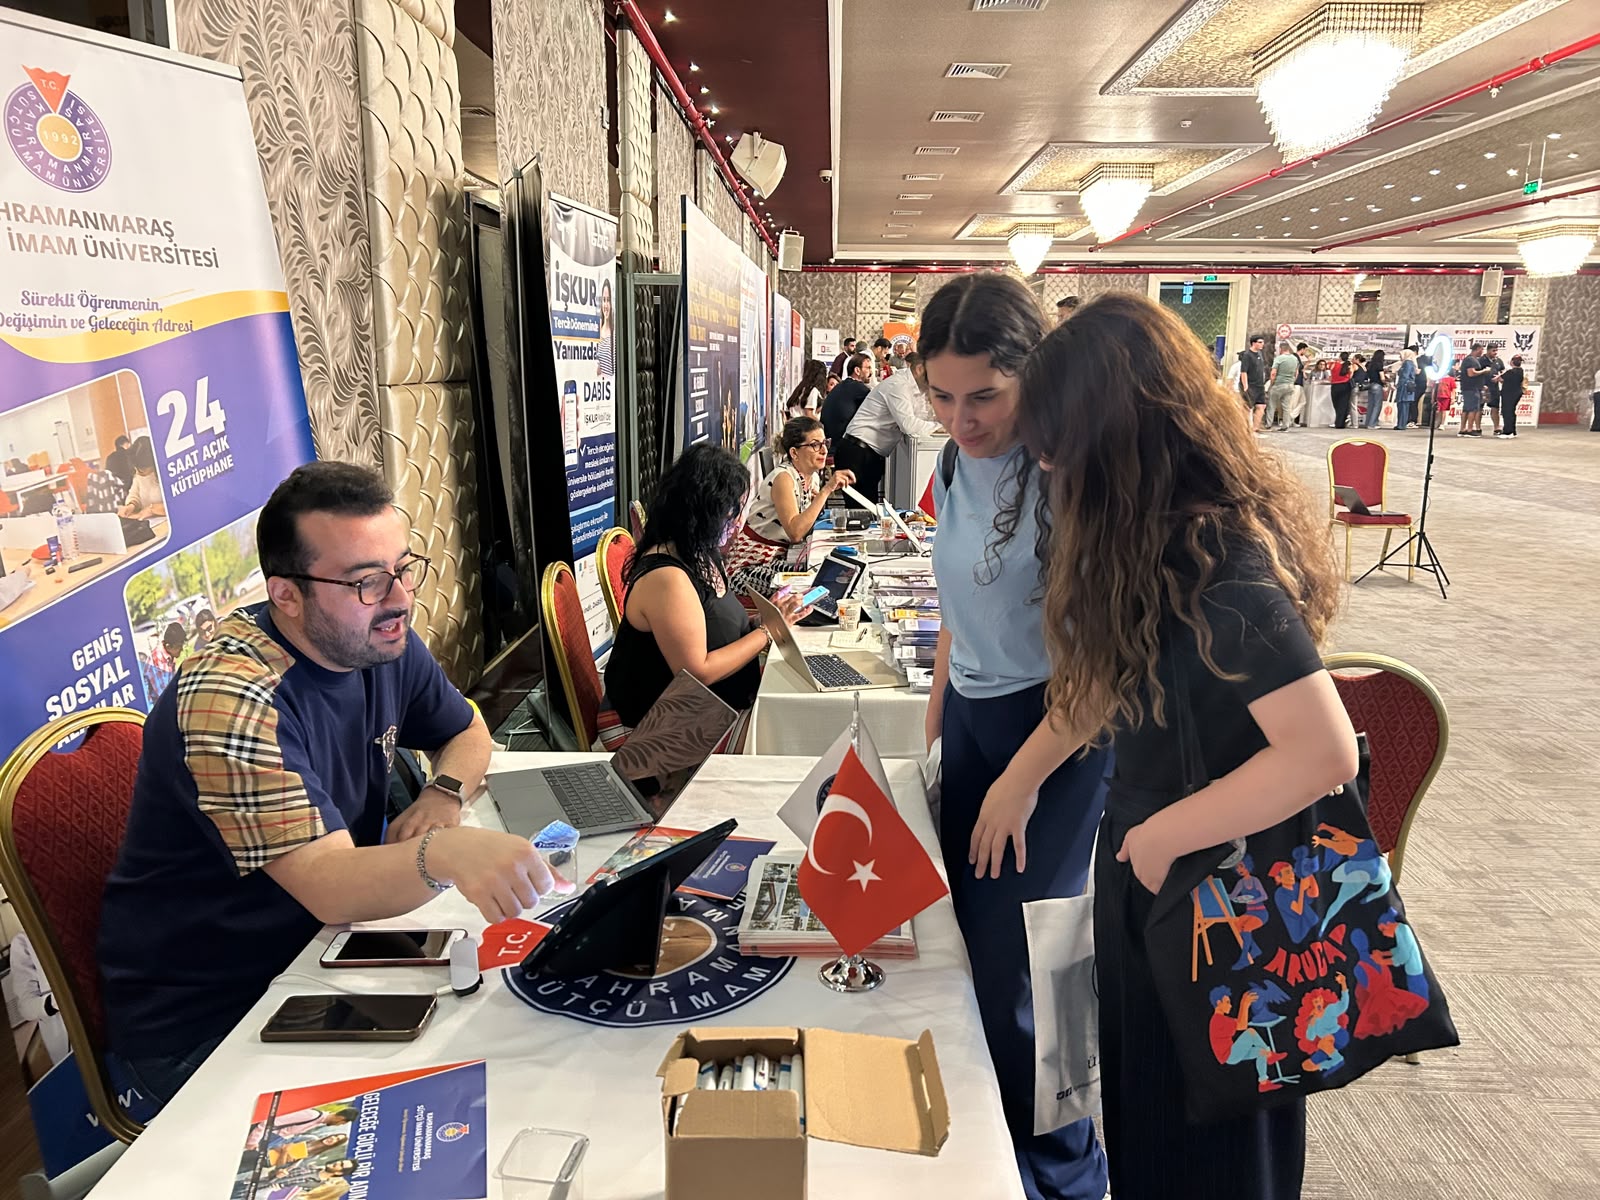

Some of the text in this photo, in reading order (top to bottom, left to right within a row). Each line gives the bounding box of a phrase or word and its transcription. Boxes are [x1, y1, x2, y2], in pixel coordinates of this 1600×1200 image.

[42, 130, 79, 146] 1992
[7, 226, 220, 269] İMAM ÜNİVERSİTESİ
[21, 289, 163, 313] Sürekli Öğrenmenin,
[555, 260, 598, 312] İŞKUR
[70, 317, 86, 329] ve
[88, 314, 150, 335] Geleceğin
[152, 317, 194, 333] Adresi
[583, 377, 612, 403] DABİS
[156, 375, 227, 459] 24
[167, 435, 230, 478] SAAT AÇIK
[170, 454, 234, 498] KÜTÜPHANE
[72, 627, 124, 671] GENİŞ
[45, 656, 131, 723] SOSYAL
[498, 931, 532, 957] T.C.
[668, 965, 771, 1014] İMAM
[358, 1092, 380, 1133] GELECEĞE
[352, 1133, 378, 1161] GÜÇLÜ
